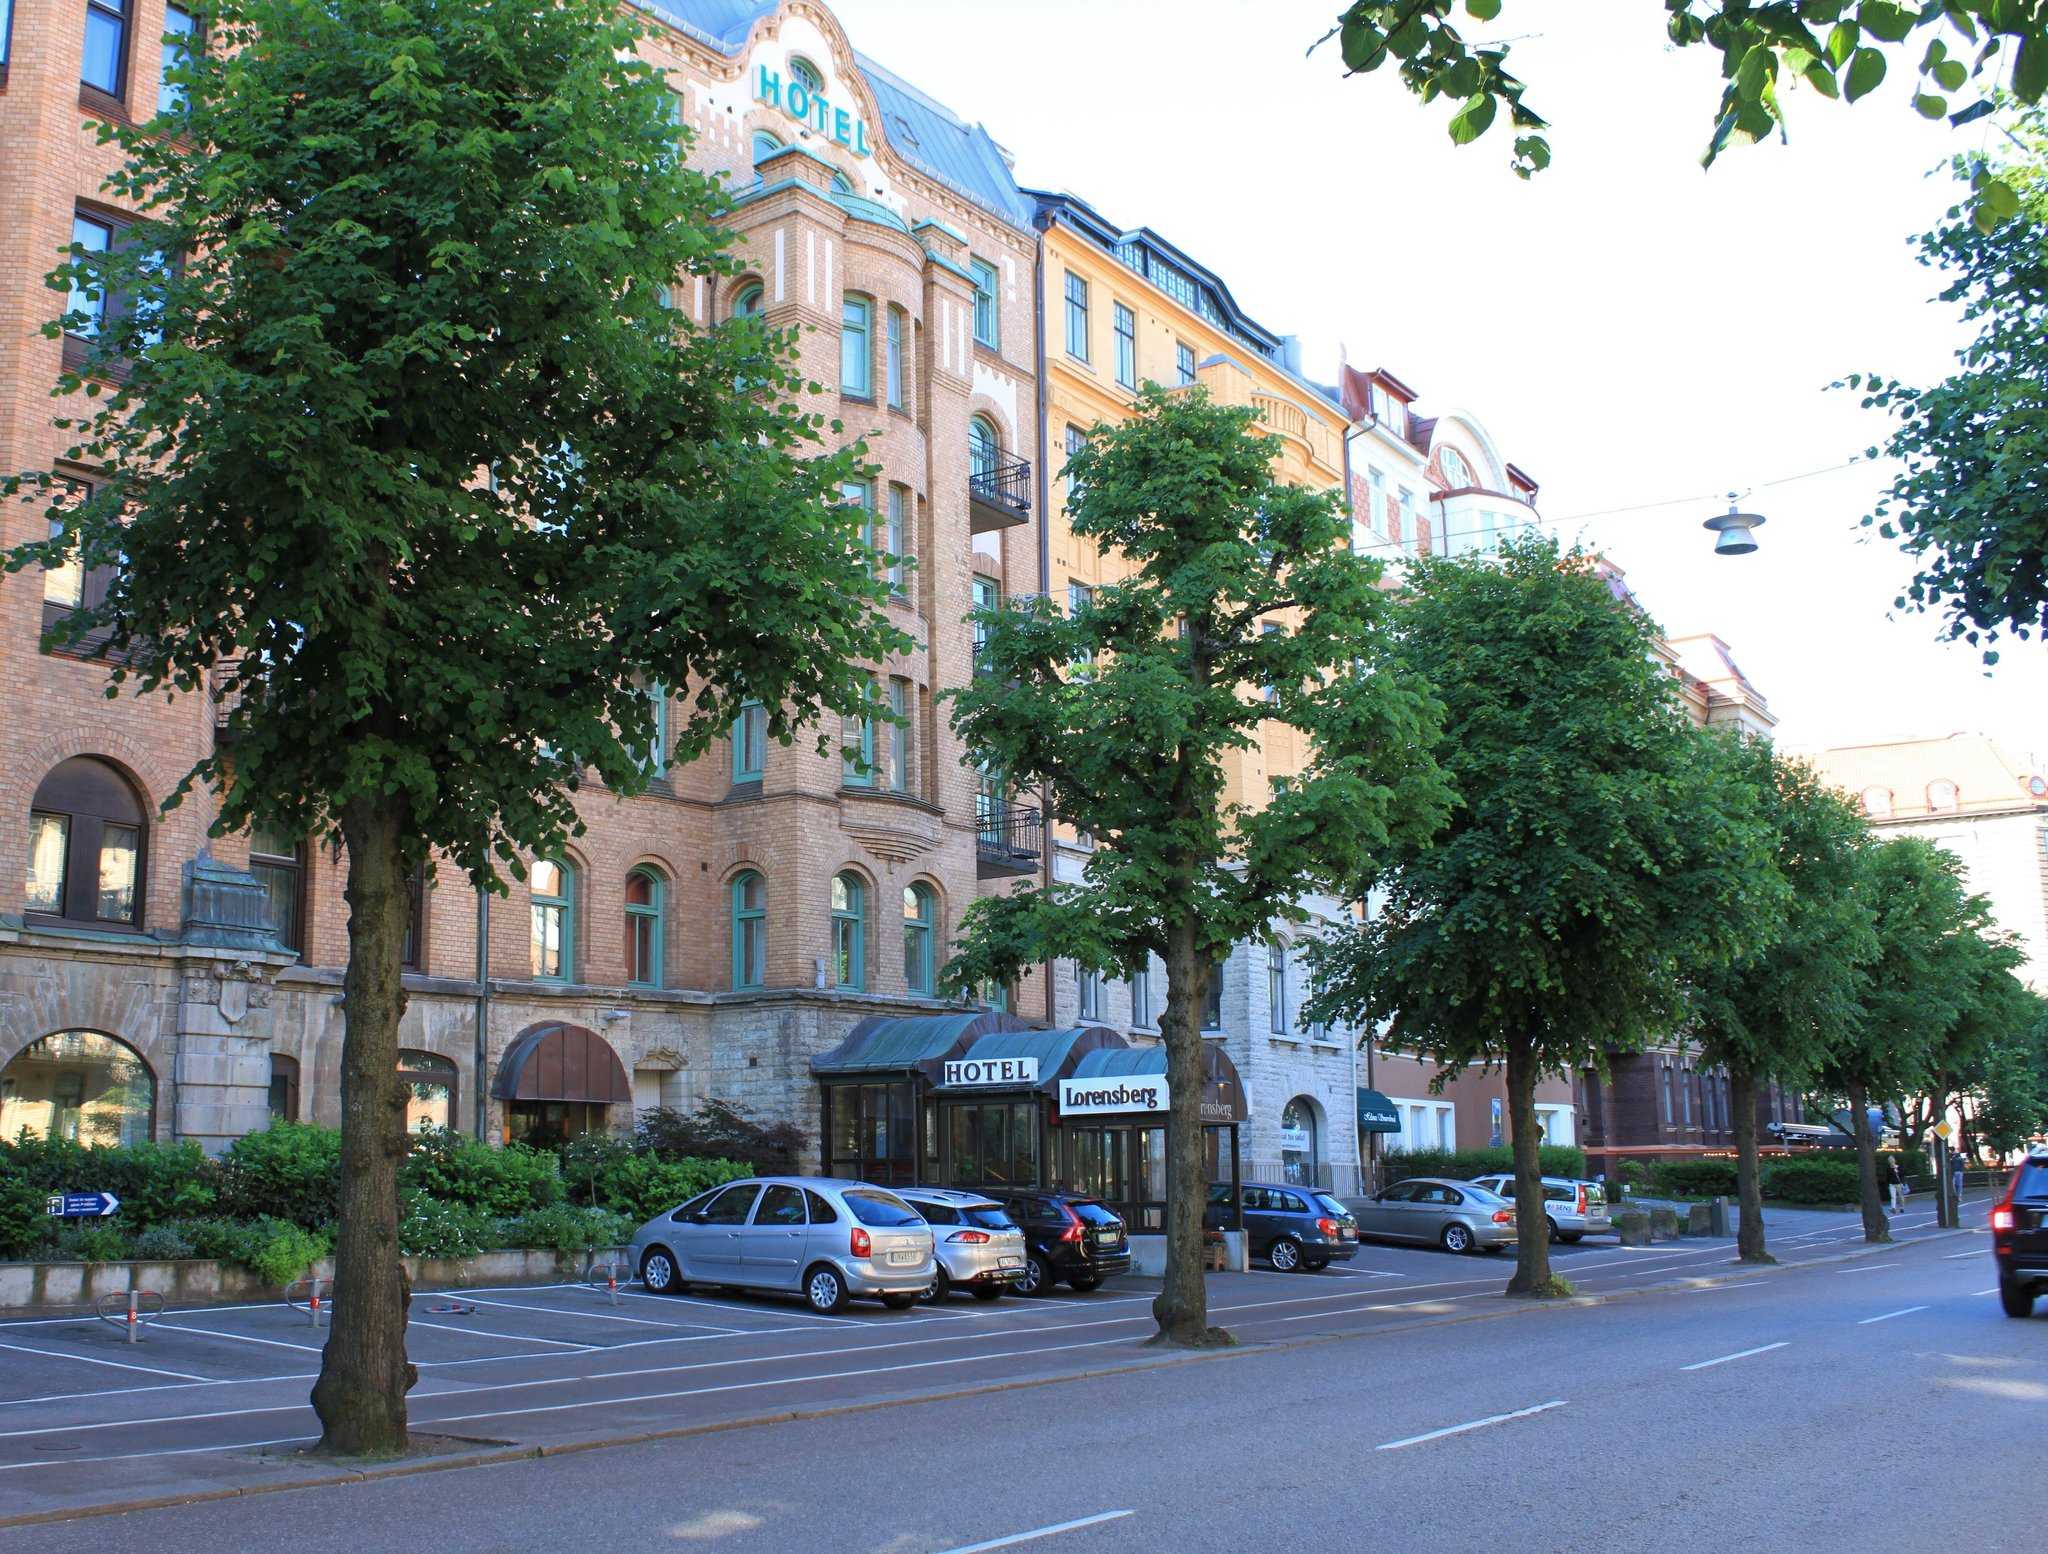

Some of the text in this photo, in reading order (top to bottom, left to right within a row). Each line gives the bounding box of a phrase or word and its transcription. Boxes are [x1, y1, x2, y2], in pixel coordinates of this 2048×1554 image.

[758, 63, 870, 157] HOTEL
[946, 1059, 1030, 1083] HOTEL
[1065, 1084, 1157, 1109] Lorensberg
[1200, 1098, 1232, 1120] rensberg
[131, 1311, 137, 1320] 8
